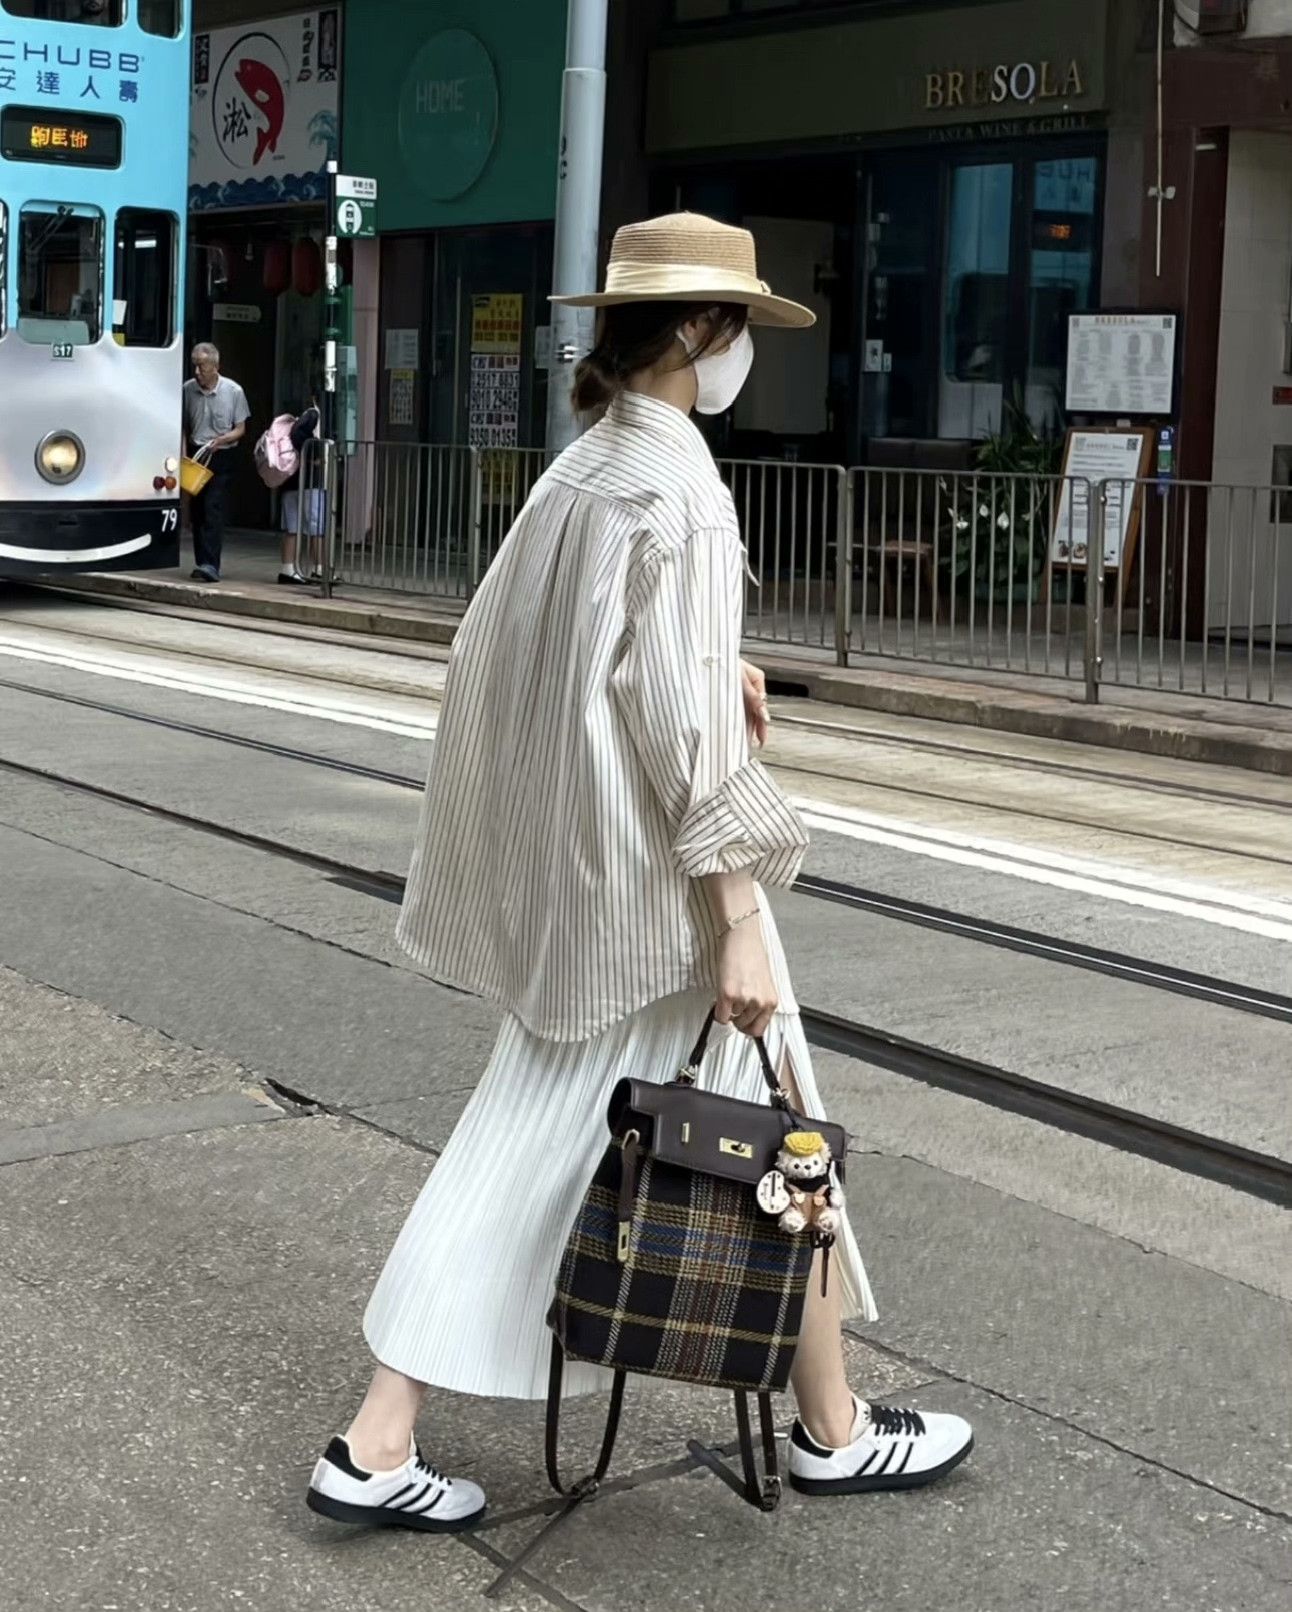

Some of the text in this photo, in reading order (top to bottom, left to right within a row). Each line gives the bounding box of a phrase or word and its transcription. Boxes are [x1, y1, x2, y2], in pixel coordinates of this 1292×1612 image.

[0, 40, 140, 73] CHUBB
[415, 79, 465, 113] HOME
[925, 59, 1083, 108] BRESOLA
[979, 123, 1023, 138] WINE
[1040, 115, 1090, 132] GRILL
[162, 508, 178, 532] 79
